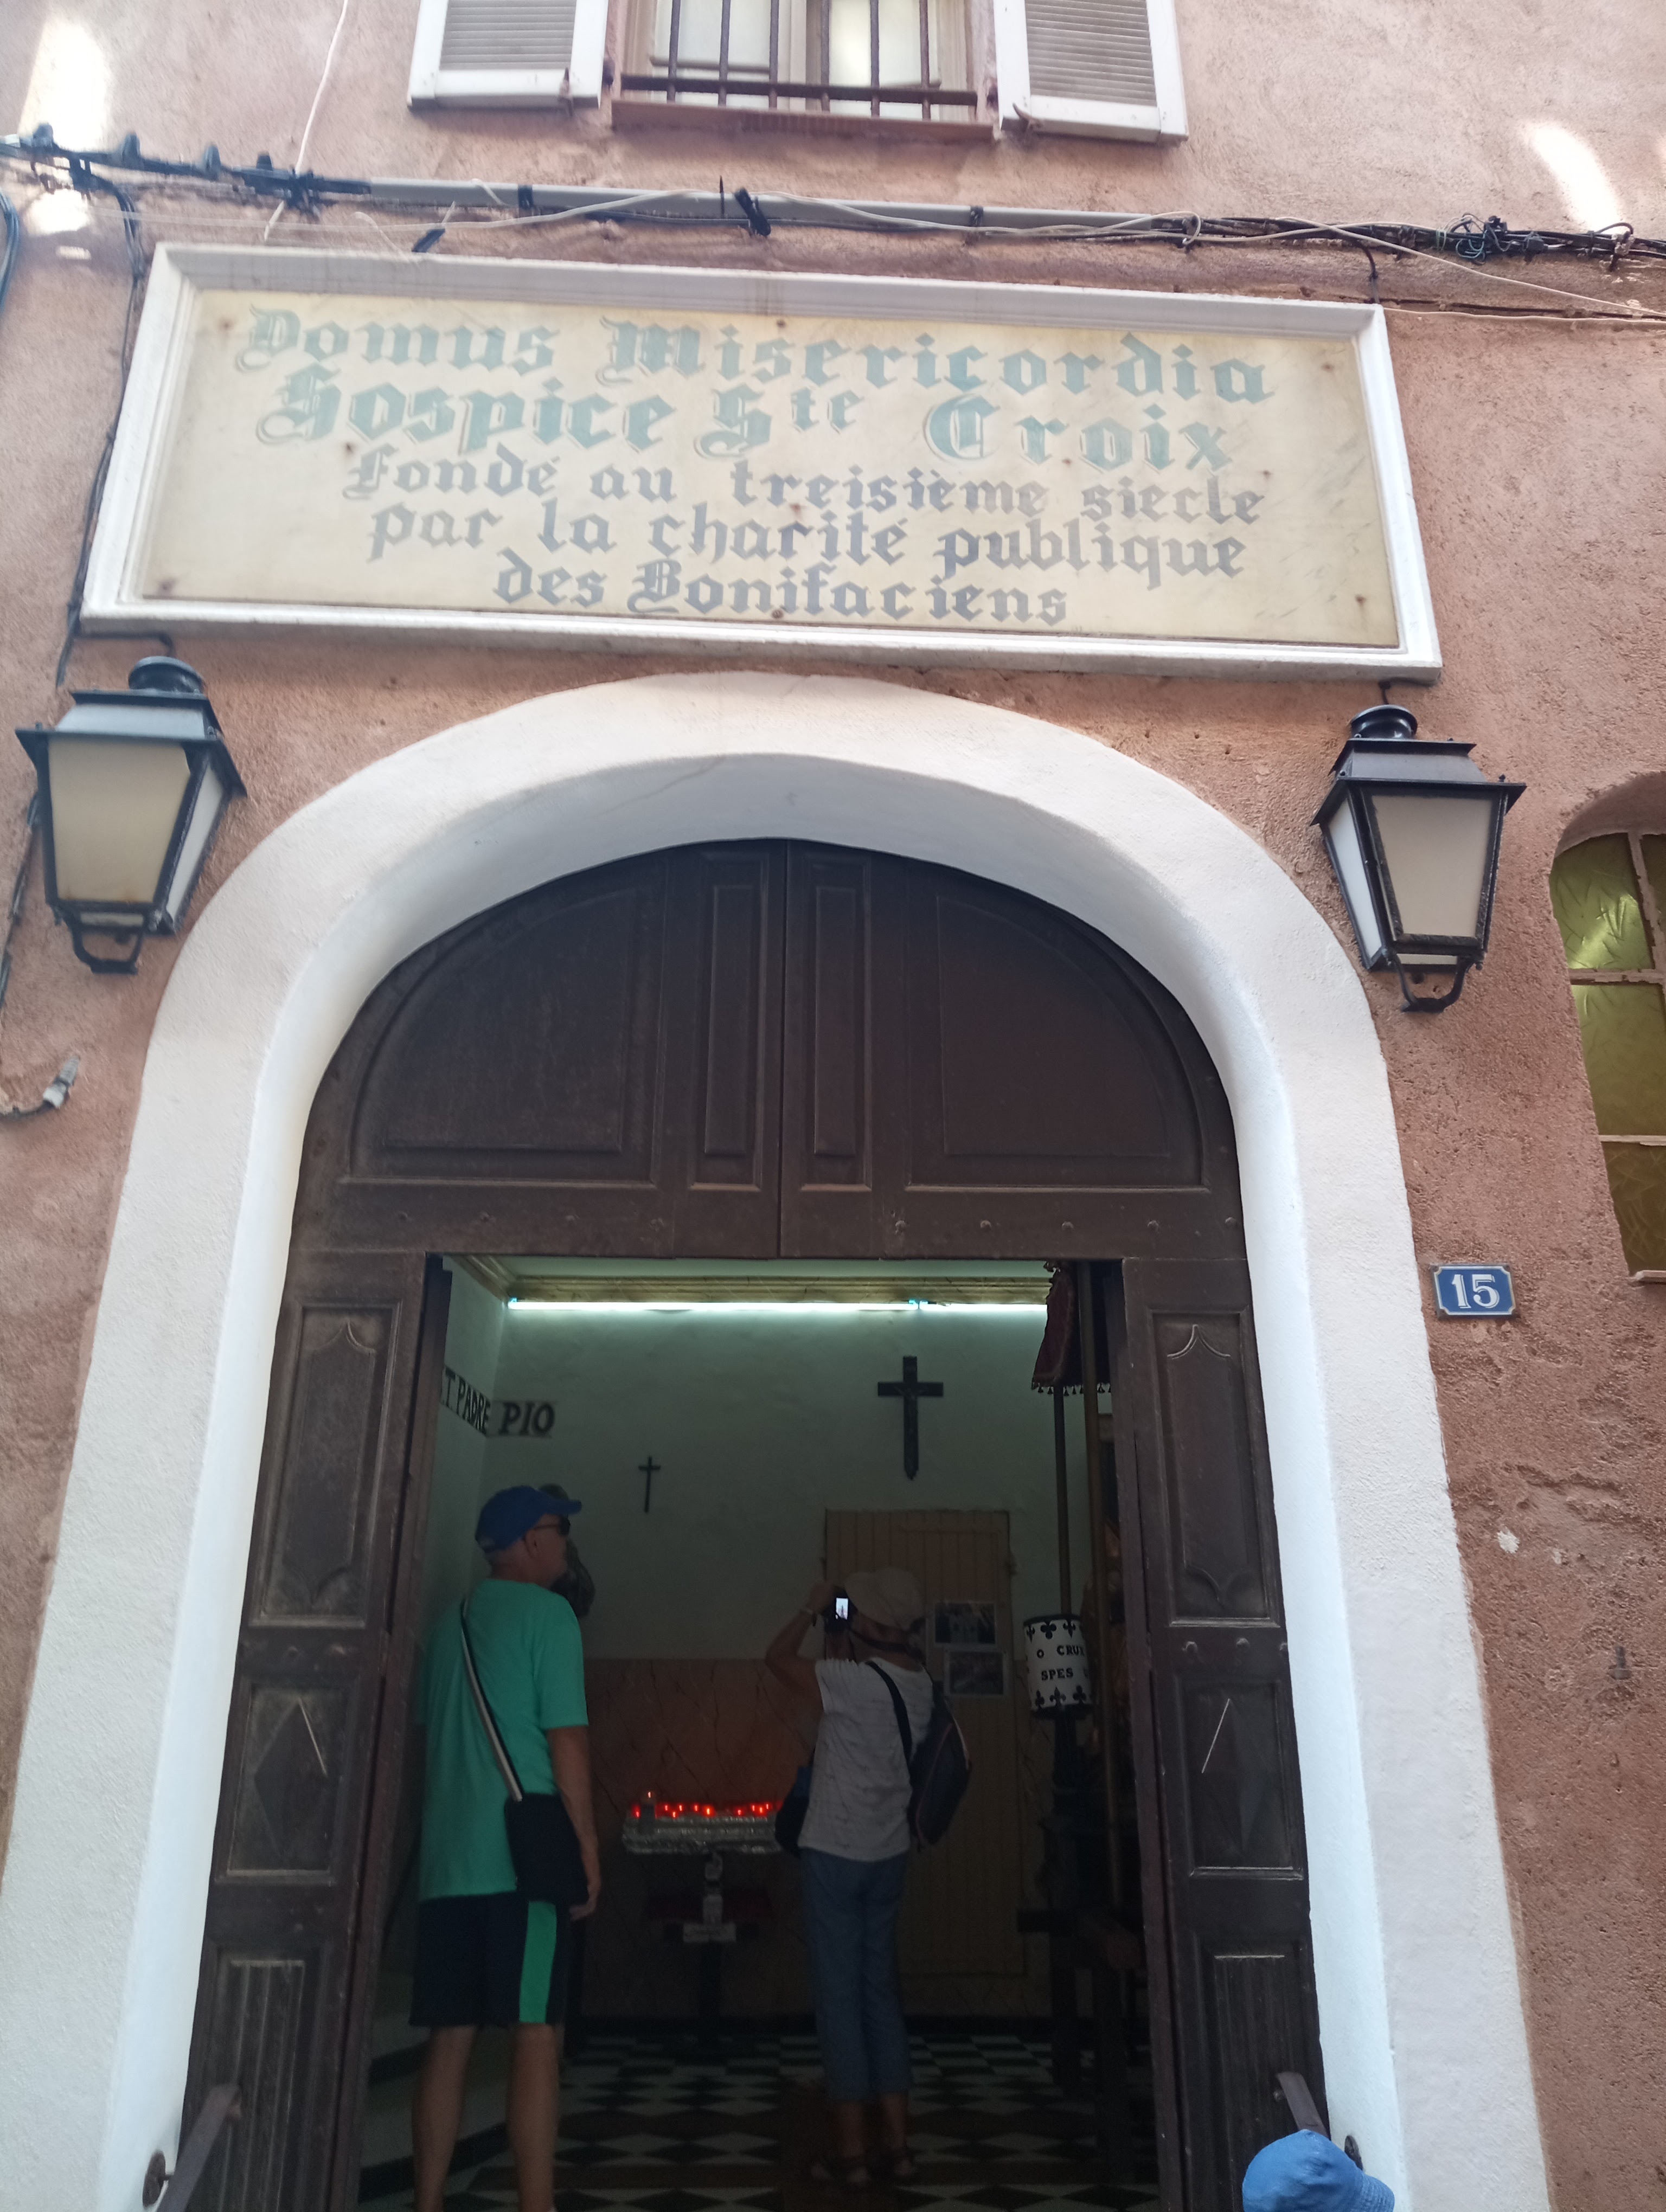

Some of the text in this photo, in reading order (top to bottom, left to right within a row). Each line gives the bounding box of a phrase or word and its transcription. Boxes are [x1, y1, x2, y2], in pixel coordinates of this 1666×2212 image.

[235, 304, 1275, 406] Domus Misericordia
[257, 362, 1233, 474] Hospice Ste Croix
[589, 463, 676, 503] au
[731, 461, 1049, 518] treisième
[1080, 475, 1265, 526] siecle
[366, 498, 1247, 591] par la charité publique
[492, 548, 1068, 627] des Bonifaciens
[1451, 1274, 1500, 1309] 15
[456, 1375, 491, 1435] PADRE
[498, 1401, 555, 1435] PIO
[1041, 1667, 1074, 1681] SPES
